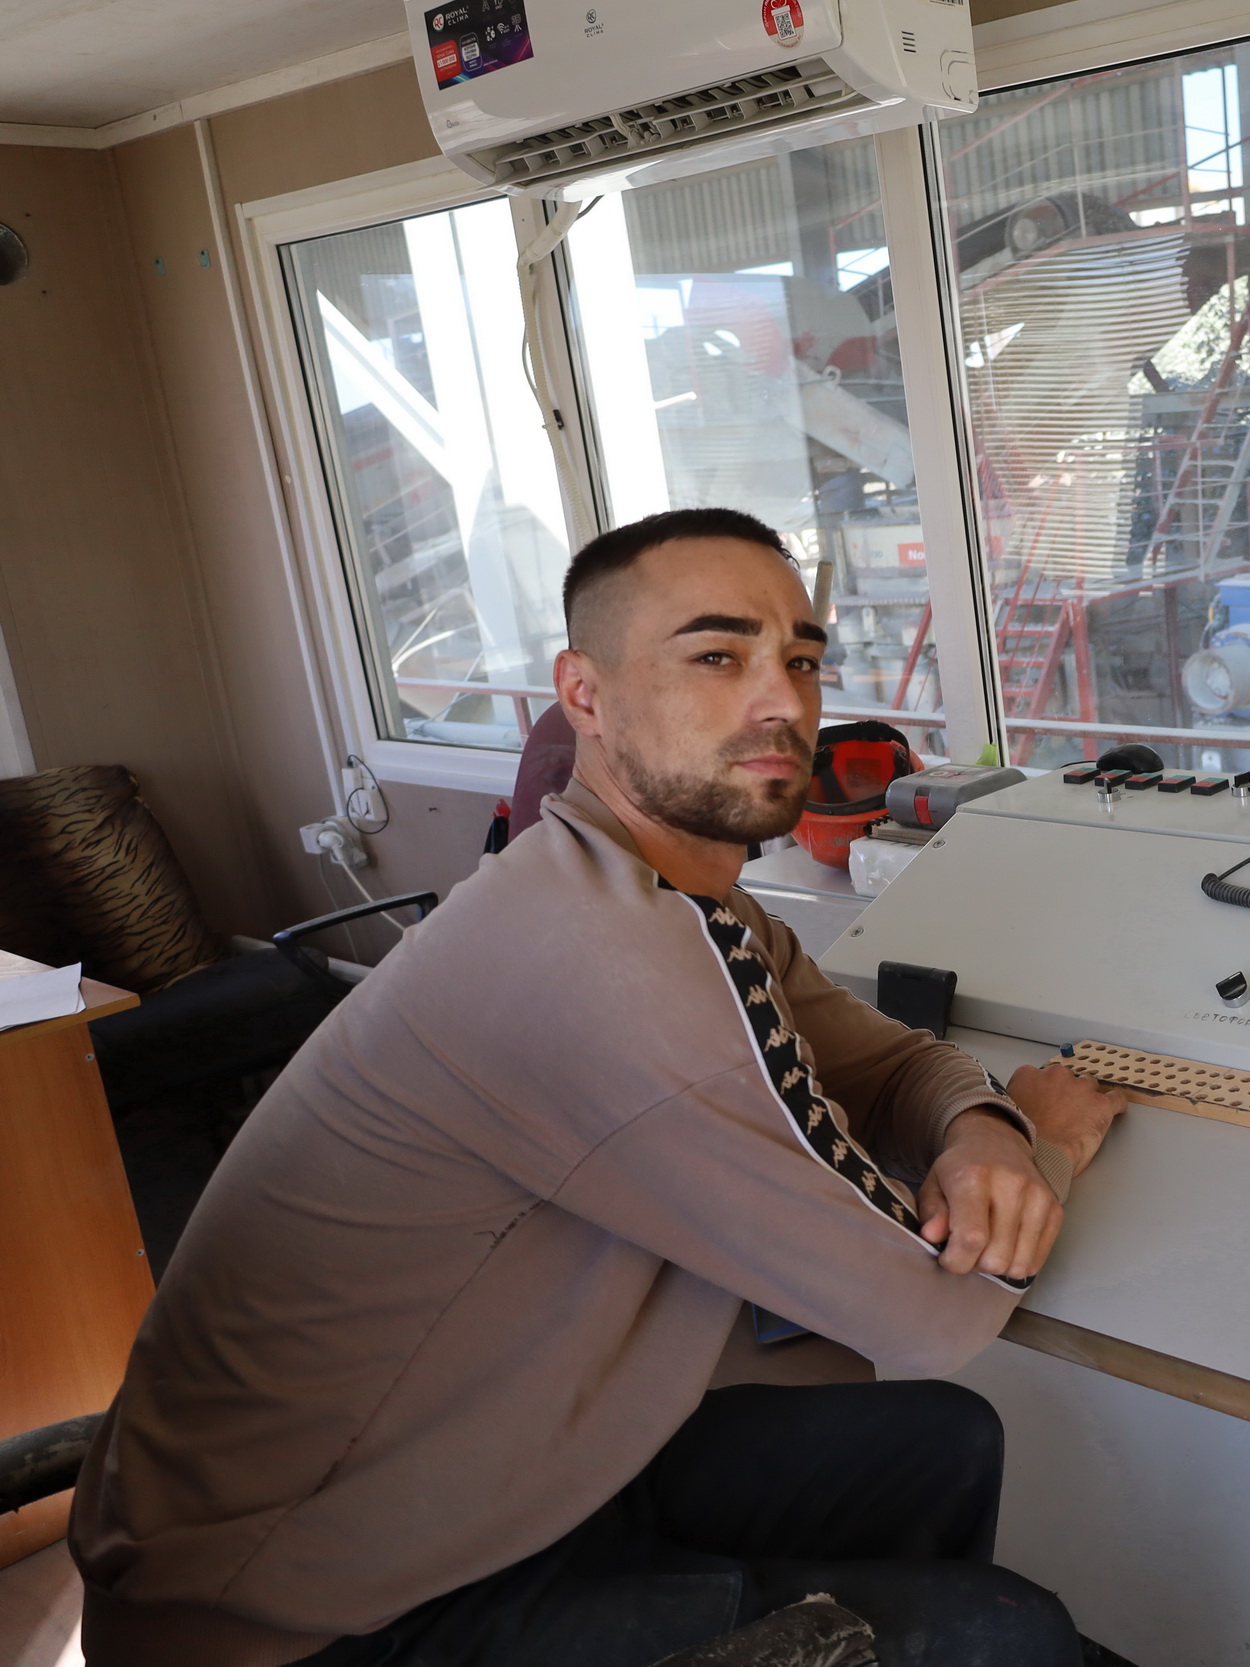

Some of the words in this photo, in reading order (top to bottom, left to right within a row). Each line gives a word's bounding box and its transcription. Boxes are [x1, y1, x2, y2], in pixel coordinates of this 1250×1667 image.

[446, 7, 467, 20] ROYAL
[448, 14, 469, 26] CLIMA
[584, 24, 603, 33] ROYAL
[586, 29, 604, 38] CLIMA
[908, 549, 926, 561] No
